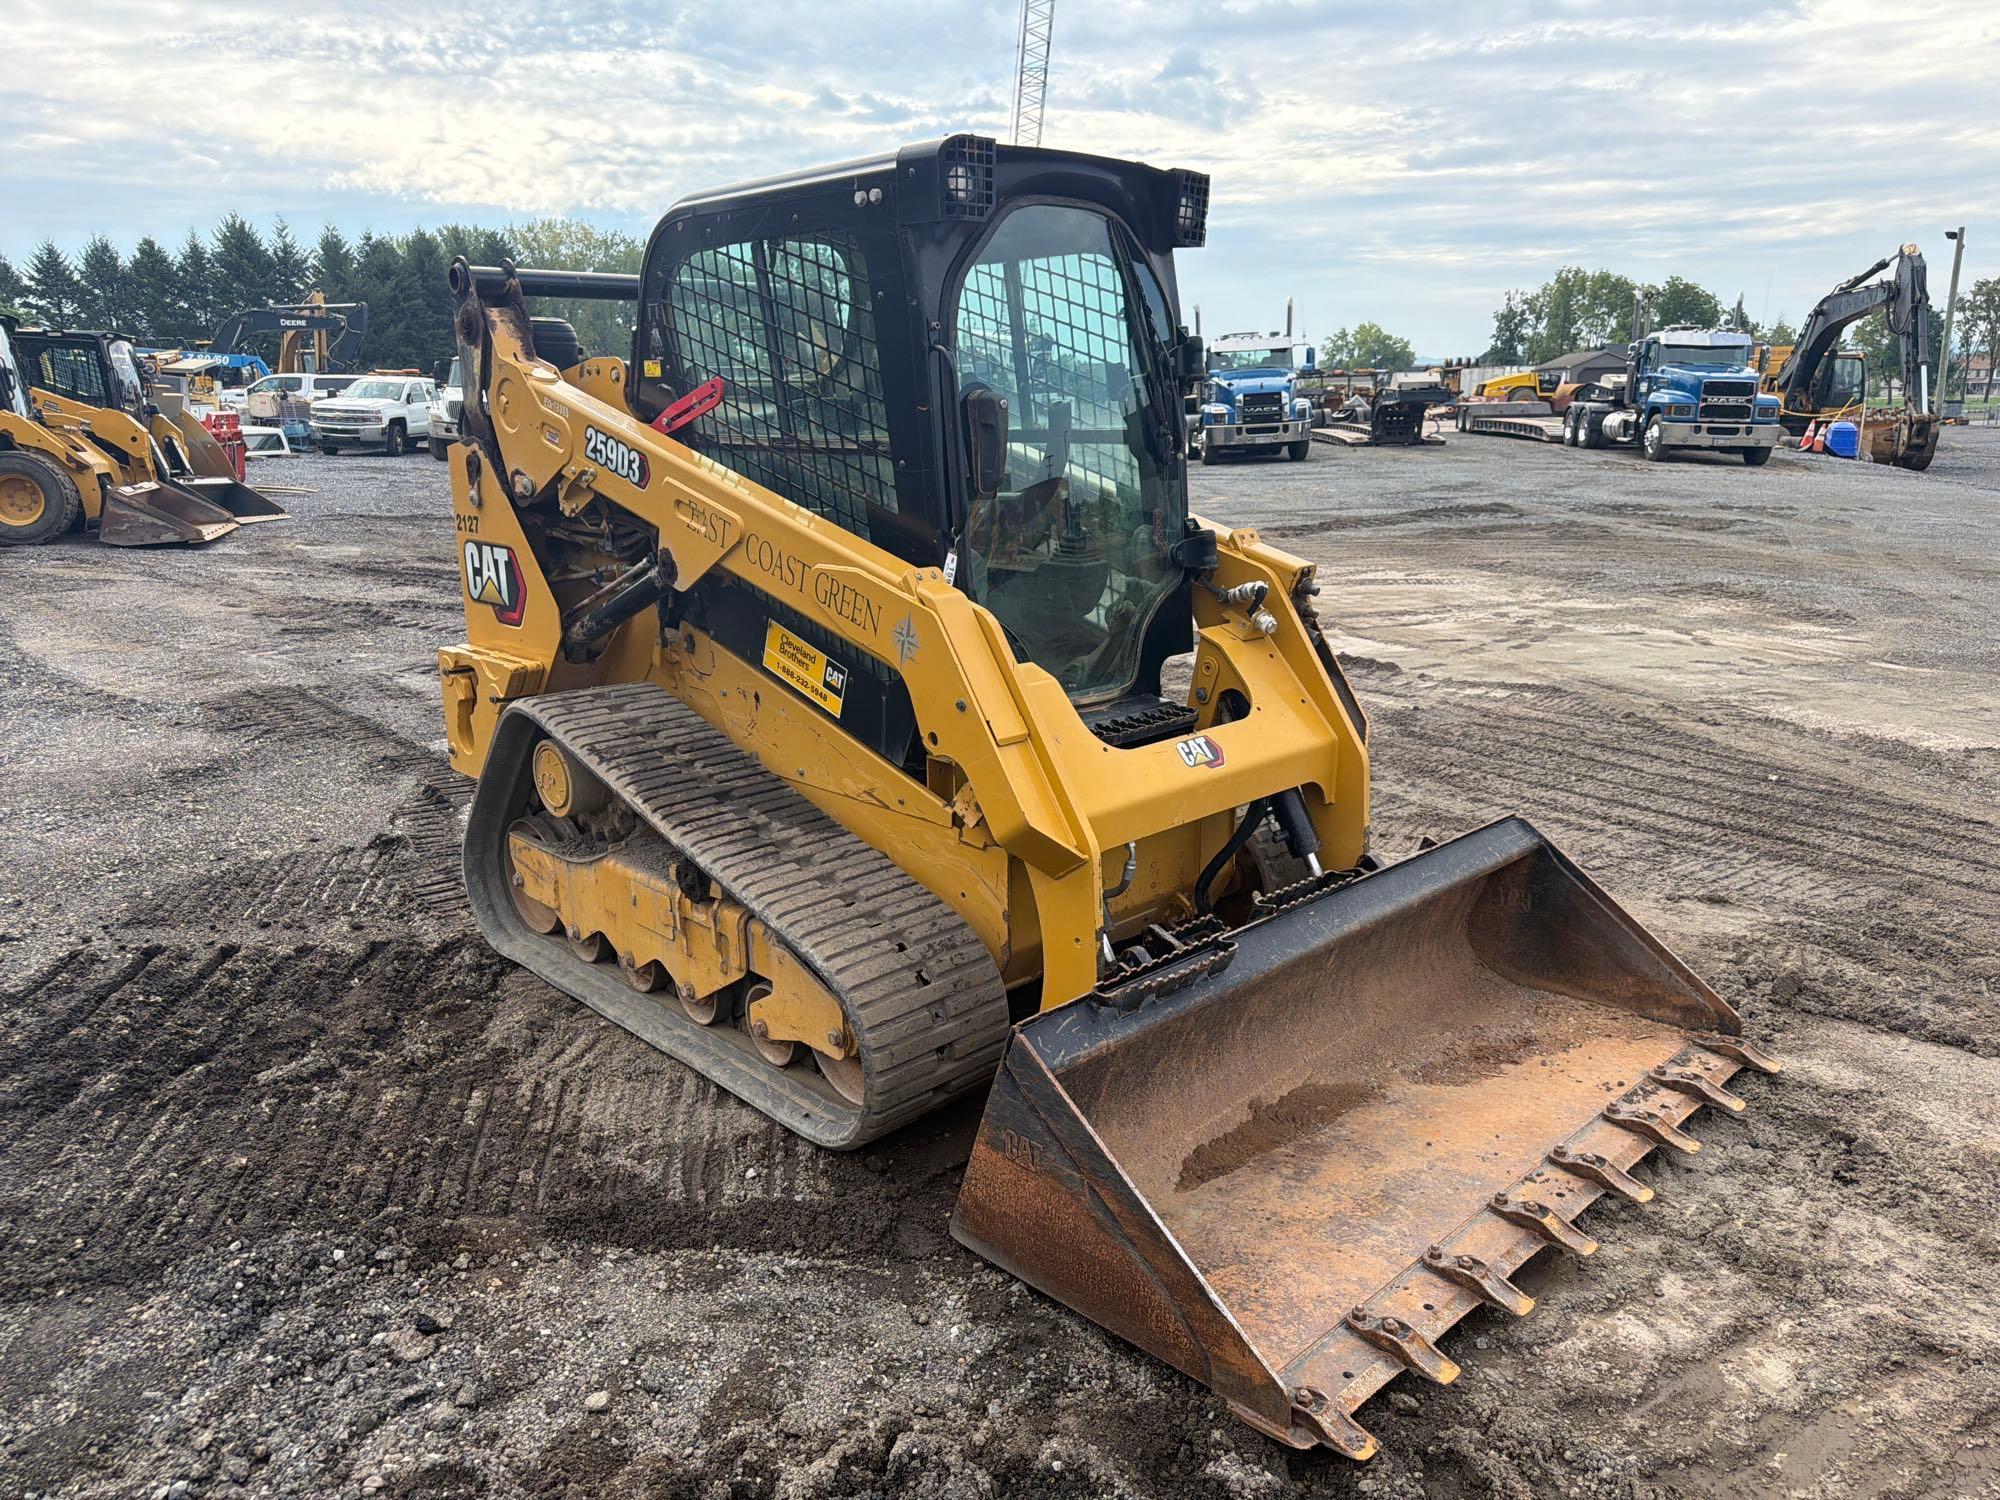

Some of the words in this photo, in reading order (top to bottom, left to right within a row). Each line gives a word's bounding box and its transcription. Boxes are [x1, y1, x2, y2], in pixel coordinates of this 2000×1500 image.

[584, 424, 641, 485] 259D3
[456, 513, 479, 533] 2127
[465, 541, 509, 606] CAT
[686, 499, 731, 548] EAST
[745, 533, 811, 594] COAST
[815, 571, 882, 636] GREEN
[779, 643, 809, 671] Brothers
[781, 633, 816, 665] Cleveland
[776, 662, 828, 702] 1-888-232-5948
[826, 666, 845, 690] CAT
[1176, 736, 1214, 767] CAT
[1003, 1129, 1043, 1172] CAT
